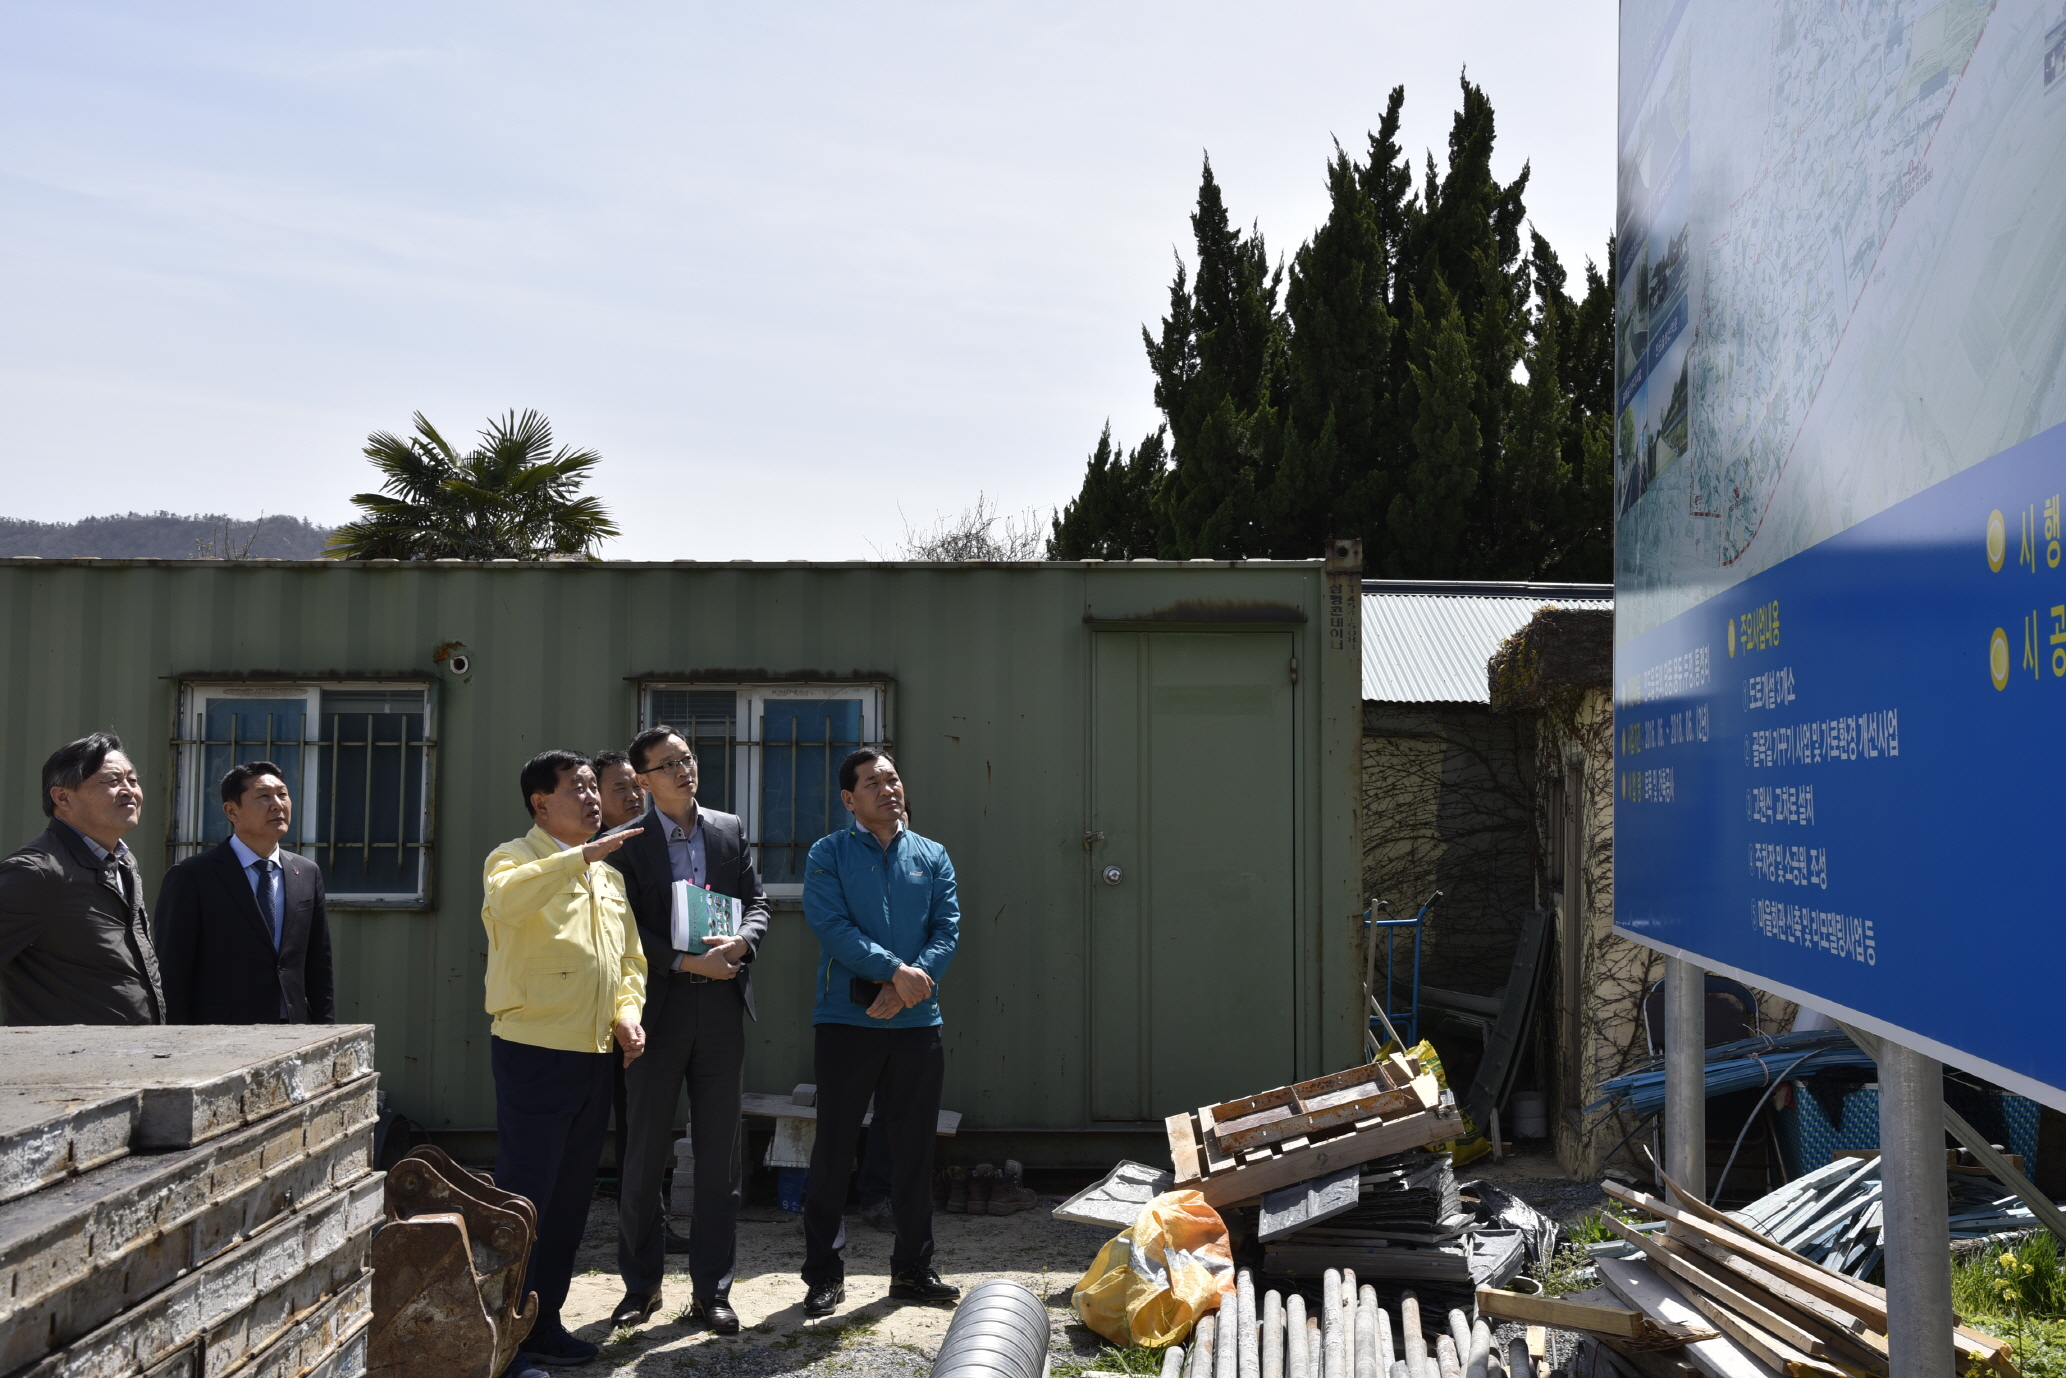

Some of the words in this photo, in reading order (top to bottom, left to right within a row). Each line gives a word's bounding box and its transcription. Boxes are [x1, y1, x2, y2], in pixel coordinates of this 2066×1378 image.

[1740, 600, 1780, 656] 주요사업내용
[1749, 670, 1776, 710] 도로개설
[1776, 666, 1796, 706] 3개소
[1752, 729, 1773, 767] 골목길
[1773, 725, 1795, 767] 가꾸기
[1796, 722, 1811, 764] 사업
[1812, 720, 1821, 763] 및
[1821, 715, 1857, 762] 가로환경
[1858, 708, 1899, 759] 개선사업
[1753, 786, 1773, 824] 고원식
[1775, 785, 1797, 825] 교차로
[1798, 784, 1814, 826] 설치
[1755, 843, 1775, 882] 주차장
[1776, 844, 1784, 884] 및
[1785, 846, 1808, 886] 소공원
[1810, 847, 1827, 890] 조성
[1758, 898, 1786, 941] 마을회관
[1787, 904, 1802, 946] 신축
[1802, 907, 1812, 949] 및
[1865, 920, 1876, 966] 등
